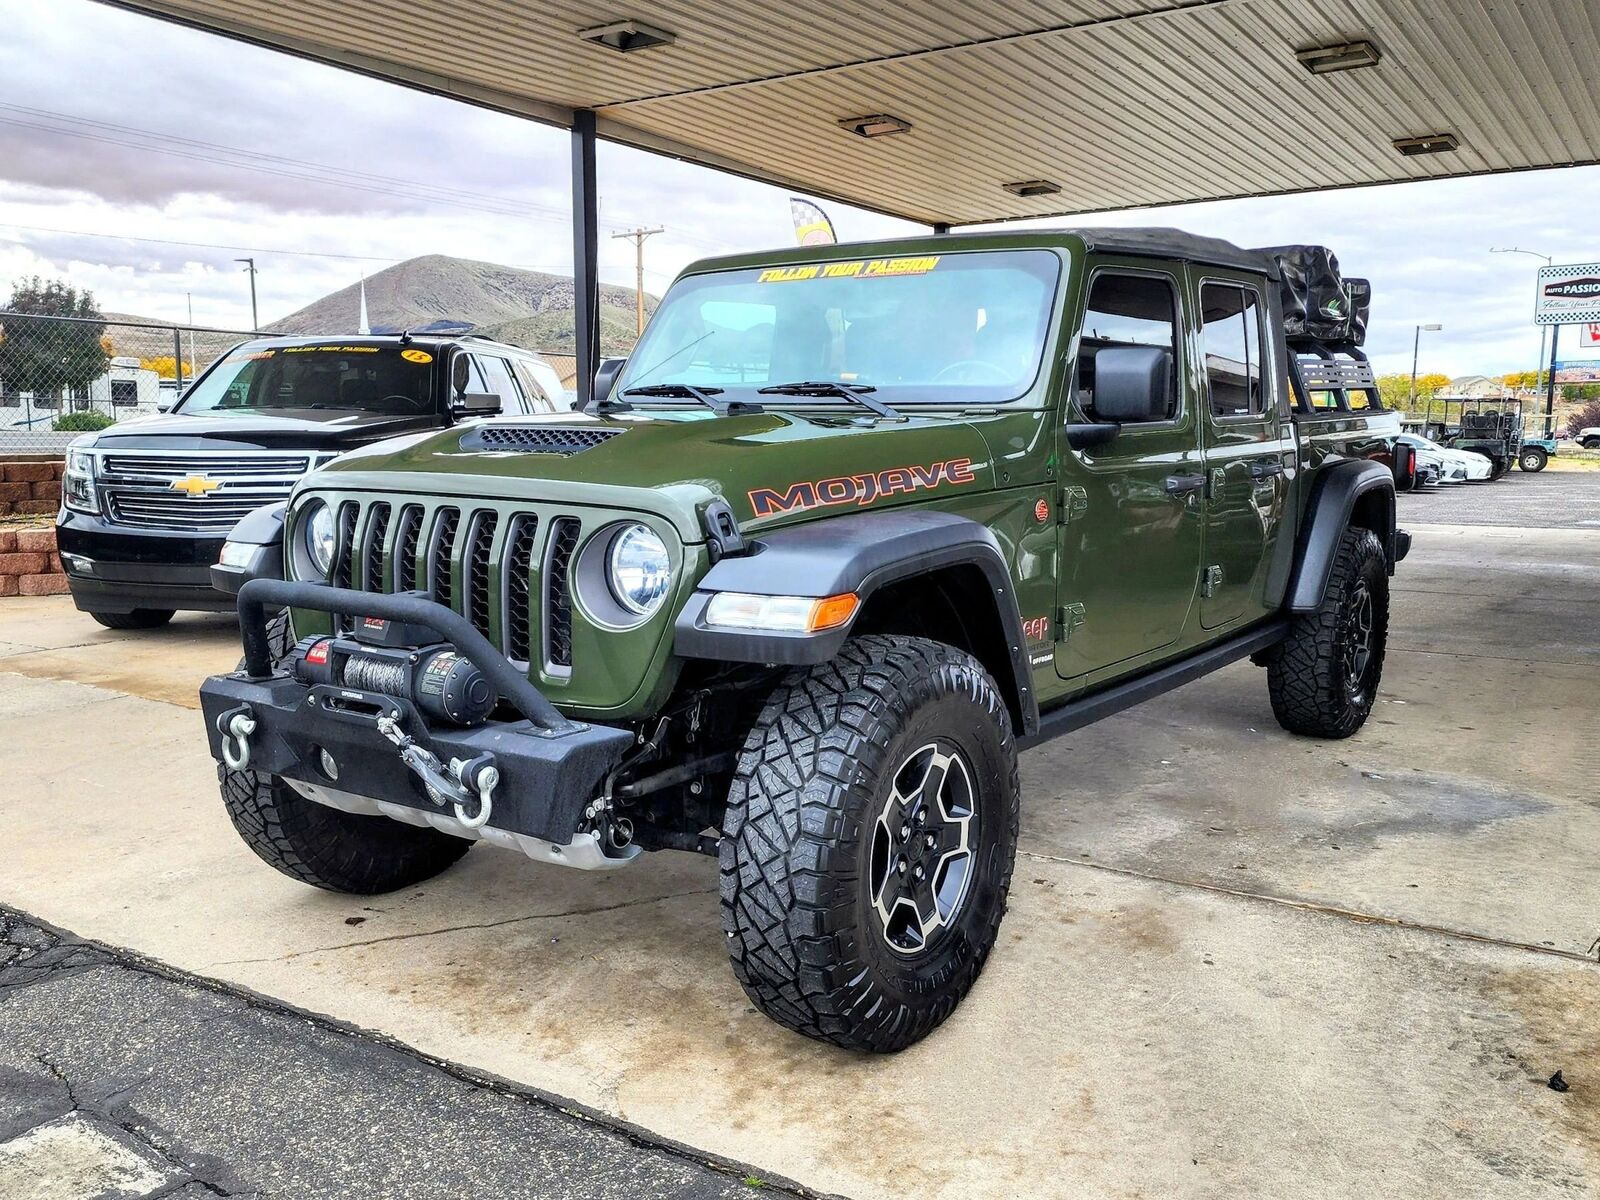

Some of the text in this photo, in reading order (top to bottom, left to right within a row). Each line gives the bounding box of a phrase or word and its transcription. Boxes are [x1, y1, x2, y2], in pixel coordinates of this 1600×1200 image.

[757, 265, 820, 283] FOLLOW
[820, 262, 865, 278] YOUR
[864, 255, 941, 275] PASSION
[748, 457, 975, 517] MOJAVE
[1020, 616, 1048, 640] eep
